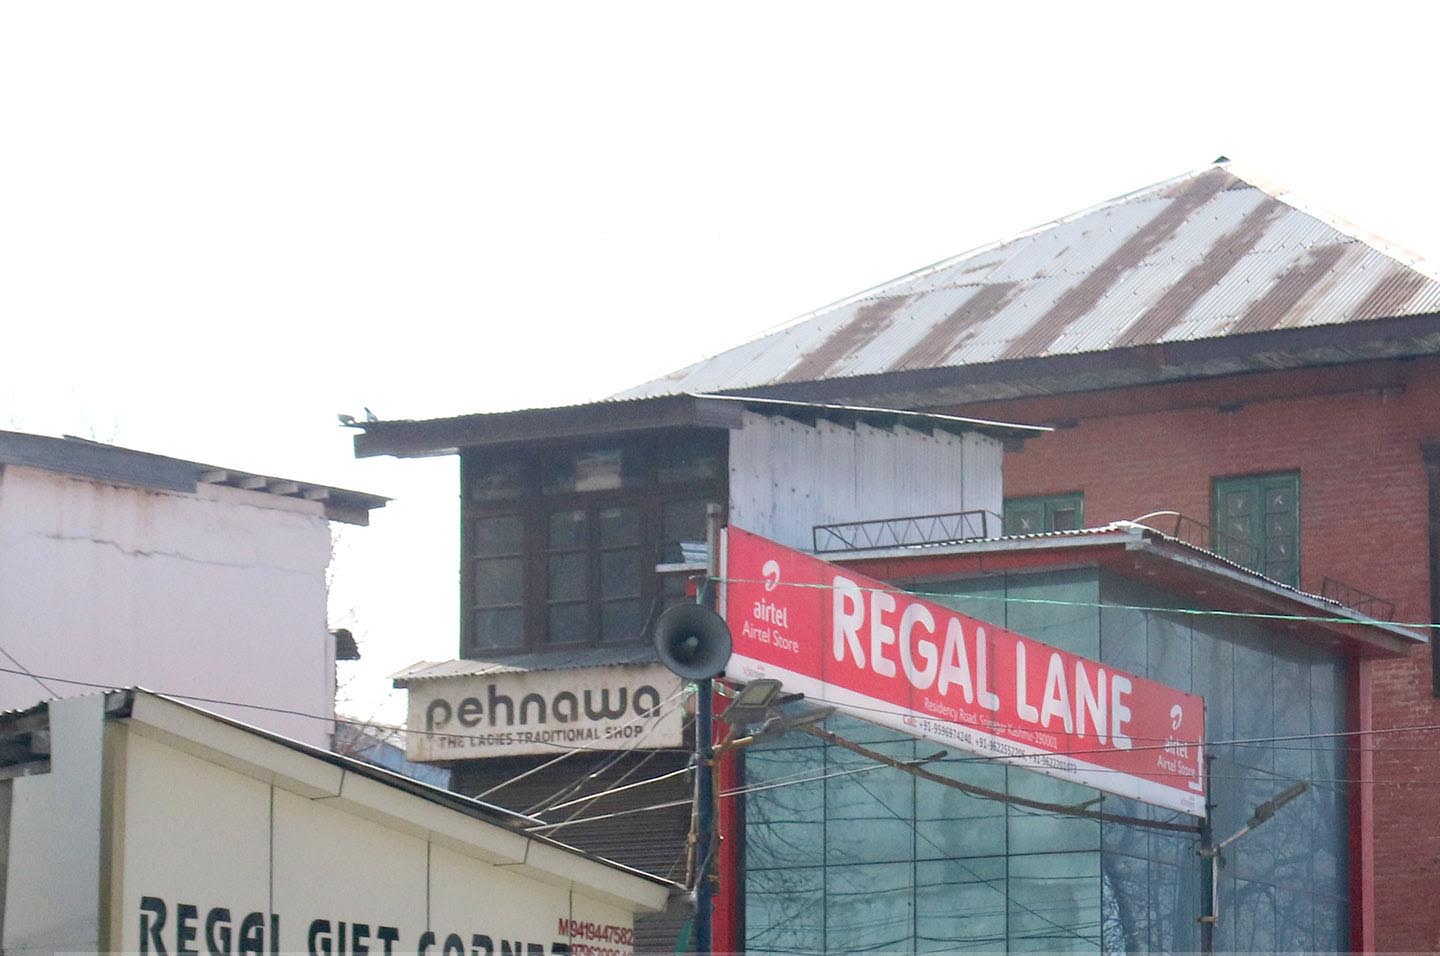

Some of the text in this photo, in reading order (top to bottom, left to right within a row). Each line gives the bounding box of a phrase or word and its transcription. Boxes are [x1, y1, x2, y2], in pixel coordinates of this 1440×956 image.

[753, 598, 788, 629] airtel
[742, 621, 799, 653] Airtel Store
[832, 575, 1133, 749] REGAL LANE
[426, 684, 661, 738] pehnawa
[924, 697, 958, 720] Residency
[440, 725, 643, 750] THE LADIES TRADITIONAL SHOP
